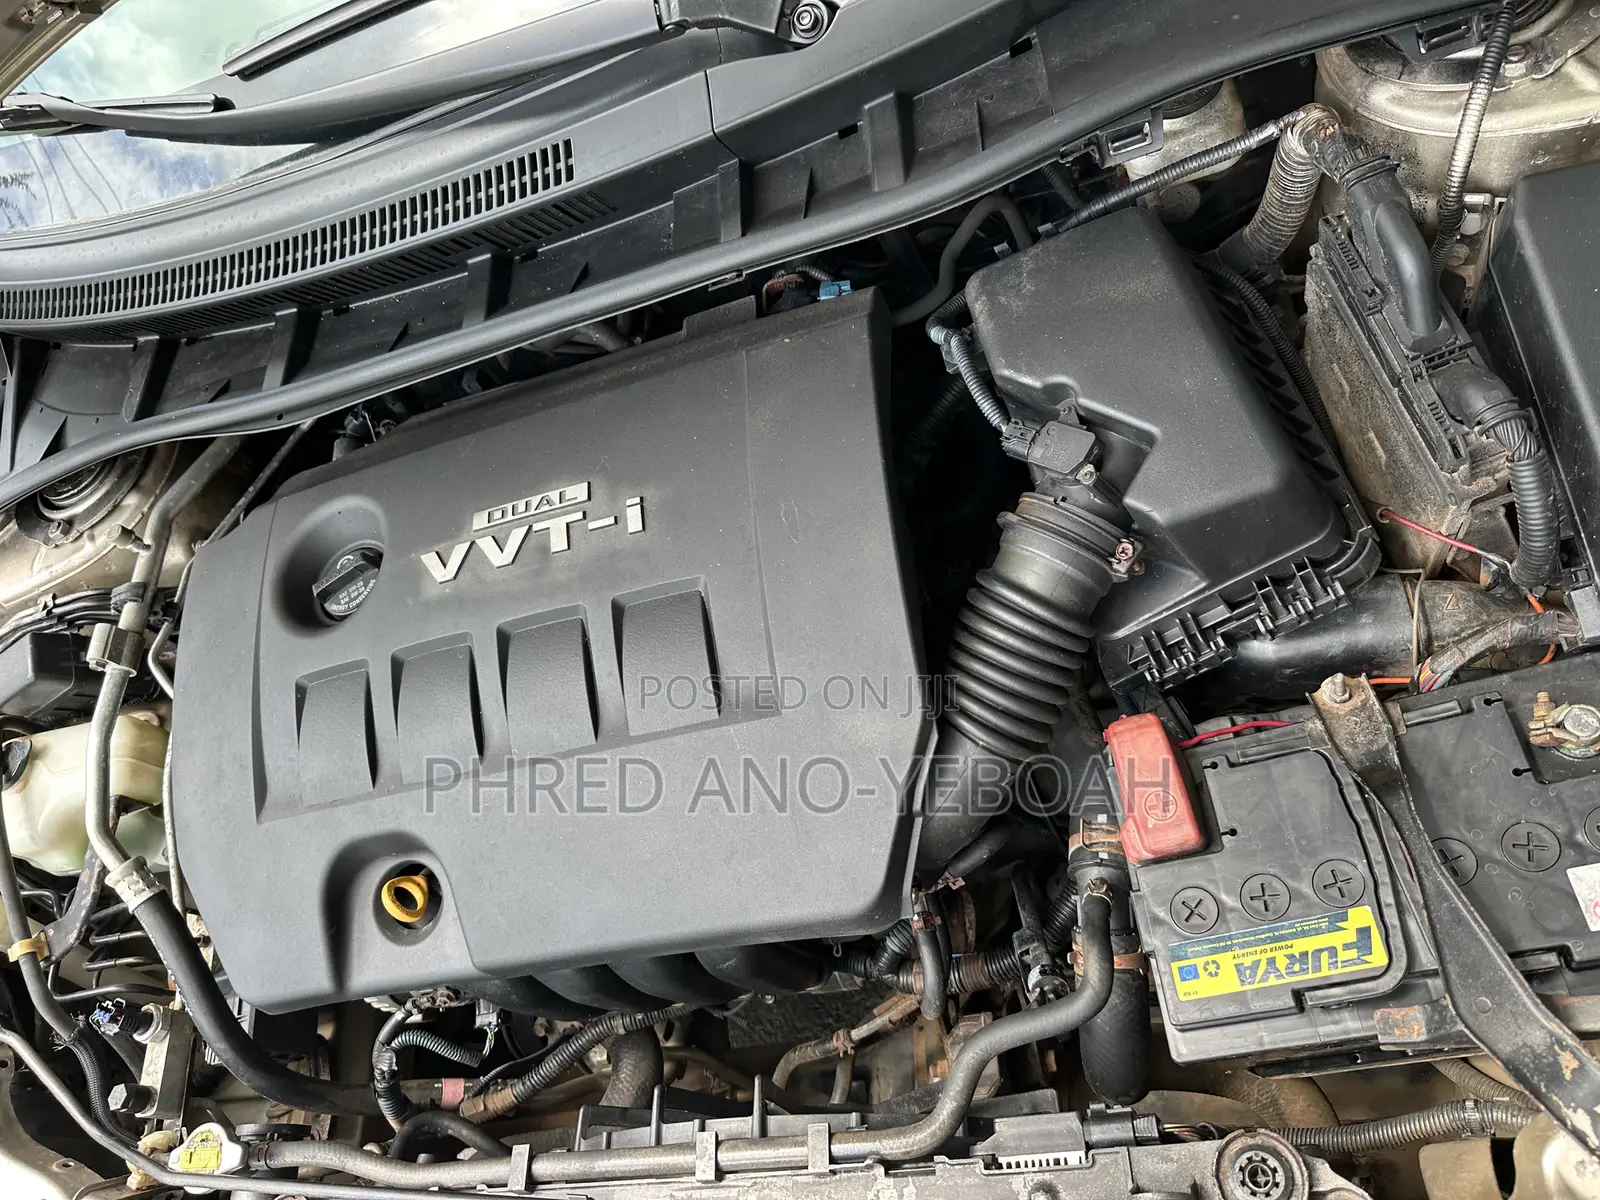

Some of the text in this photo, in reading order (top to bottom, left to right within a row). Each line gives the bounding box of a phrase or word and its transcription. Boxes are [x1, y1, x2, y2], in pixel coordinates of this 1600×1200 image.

[486, 488, 580, 525] DUAL
[420, 496, 645, 584] VVT-i
[349, 579, 376, 608] CONSERVING
[1232, 943, 1294, 960] POWER OF ENERGY
[1234, 925, 1374, 986] FURYA
